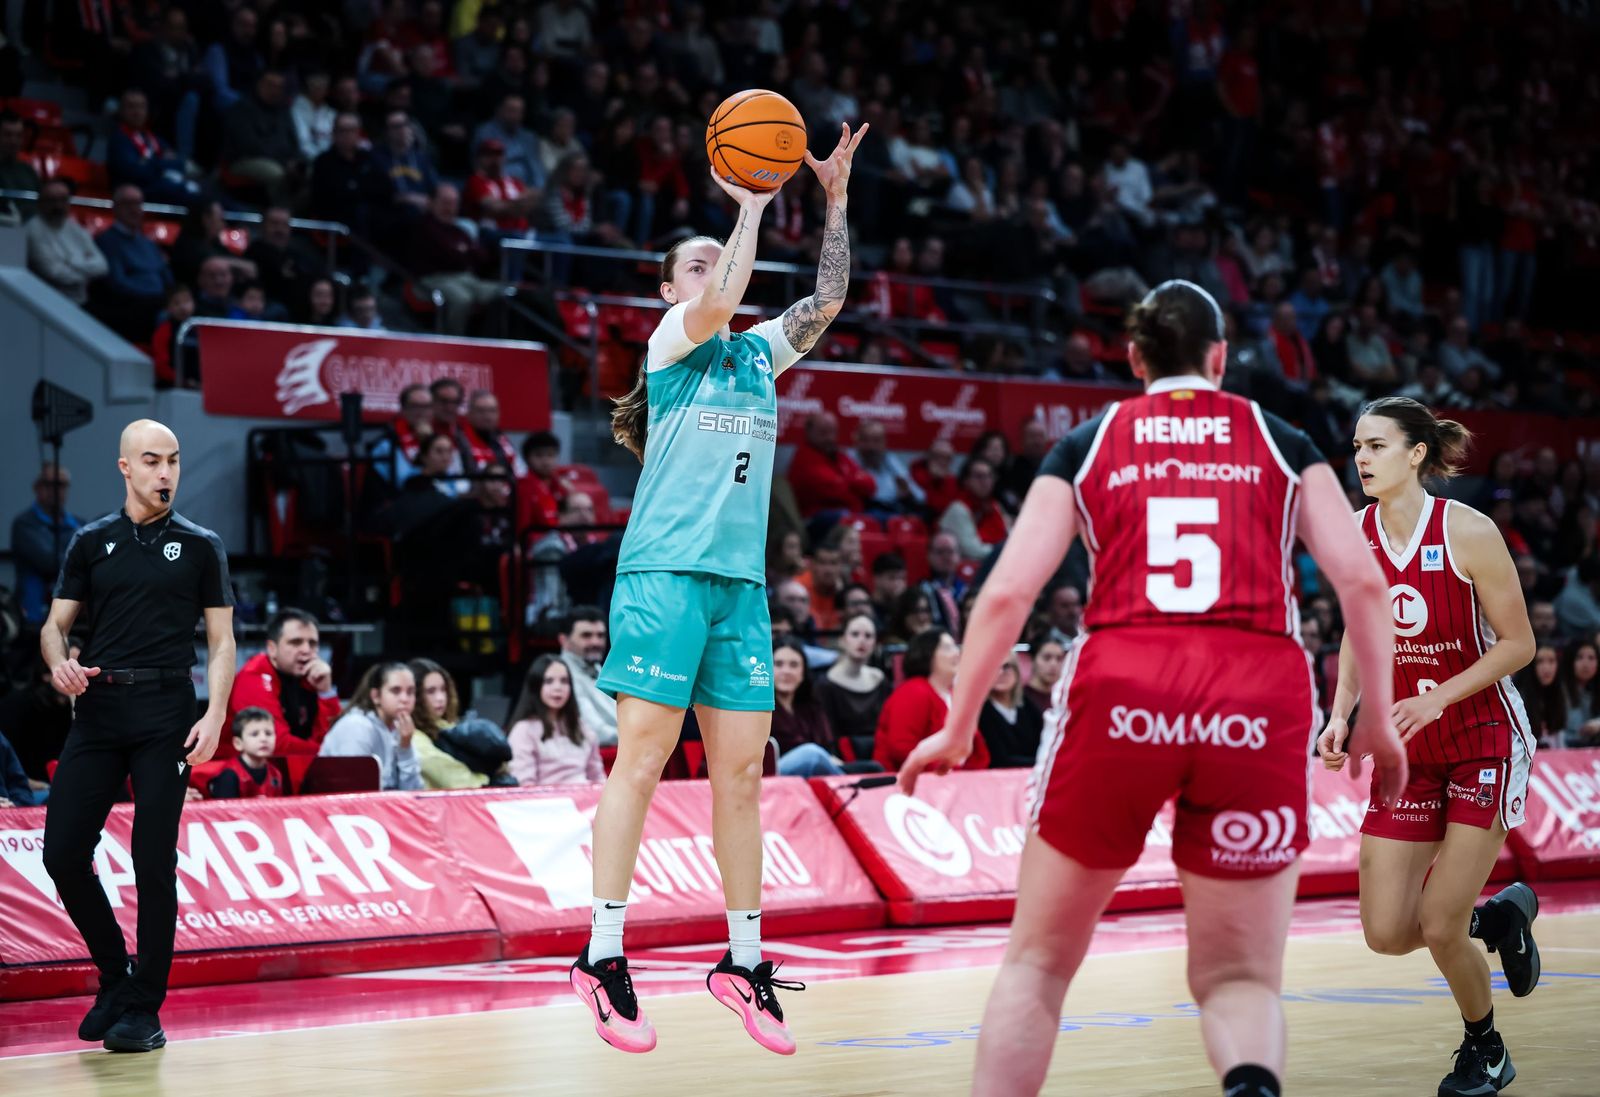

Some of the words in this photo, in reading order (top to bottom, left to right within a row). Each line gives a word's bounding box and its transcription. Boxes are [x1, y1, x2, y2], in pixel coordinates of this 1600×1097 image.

[698, 411, 751, 435] SGM
[1134, 416, 1231, 445] HEMPE
[734, 452, 751, 485] 2
[1107, 464, 1139, 491] AIR
[1144, 458, 1263, 486] HORIZONT
[1145, 496, 1221, 613] 5
[1393, 638, 1463, 655] ademont
[1108, 705, 1268, 750] SOMMOS
[1392, 813, 1429, 822] HOTELES
[94, 814, 434, 908] AMBAR
[176, 908, 275, 932] EQUEÑOS
[280, 900, 412, 924] CERVECEROS
